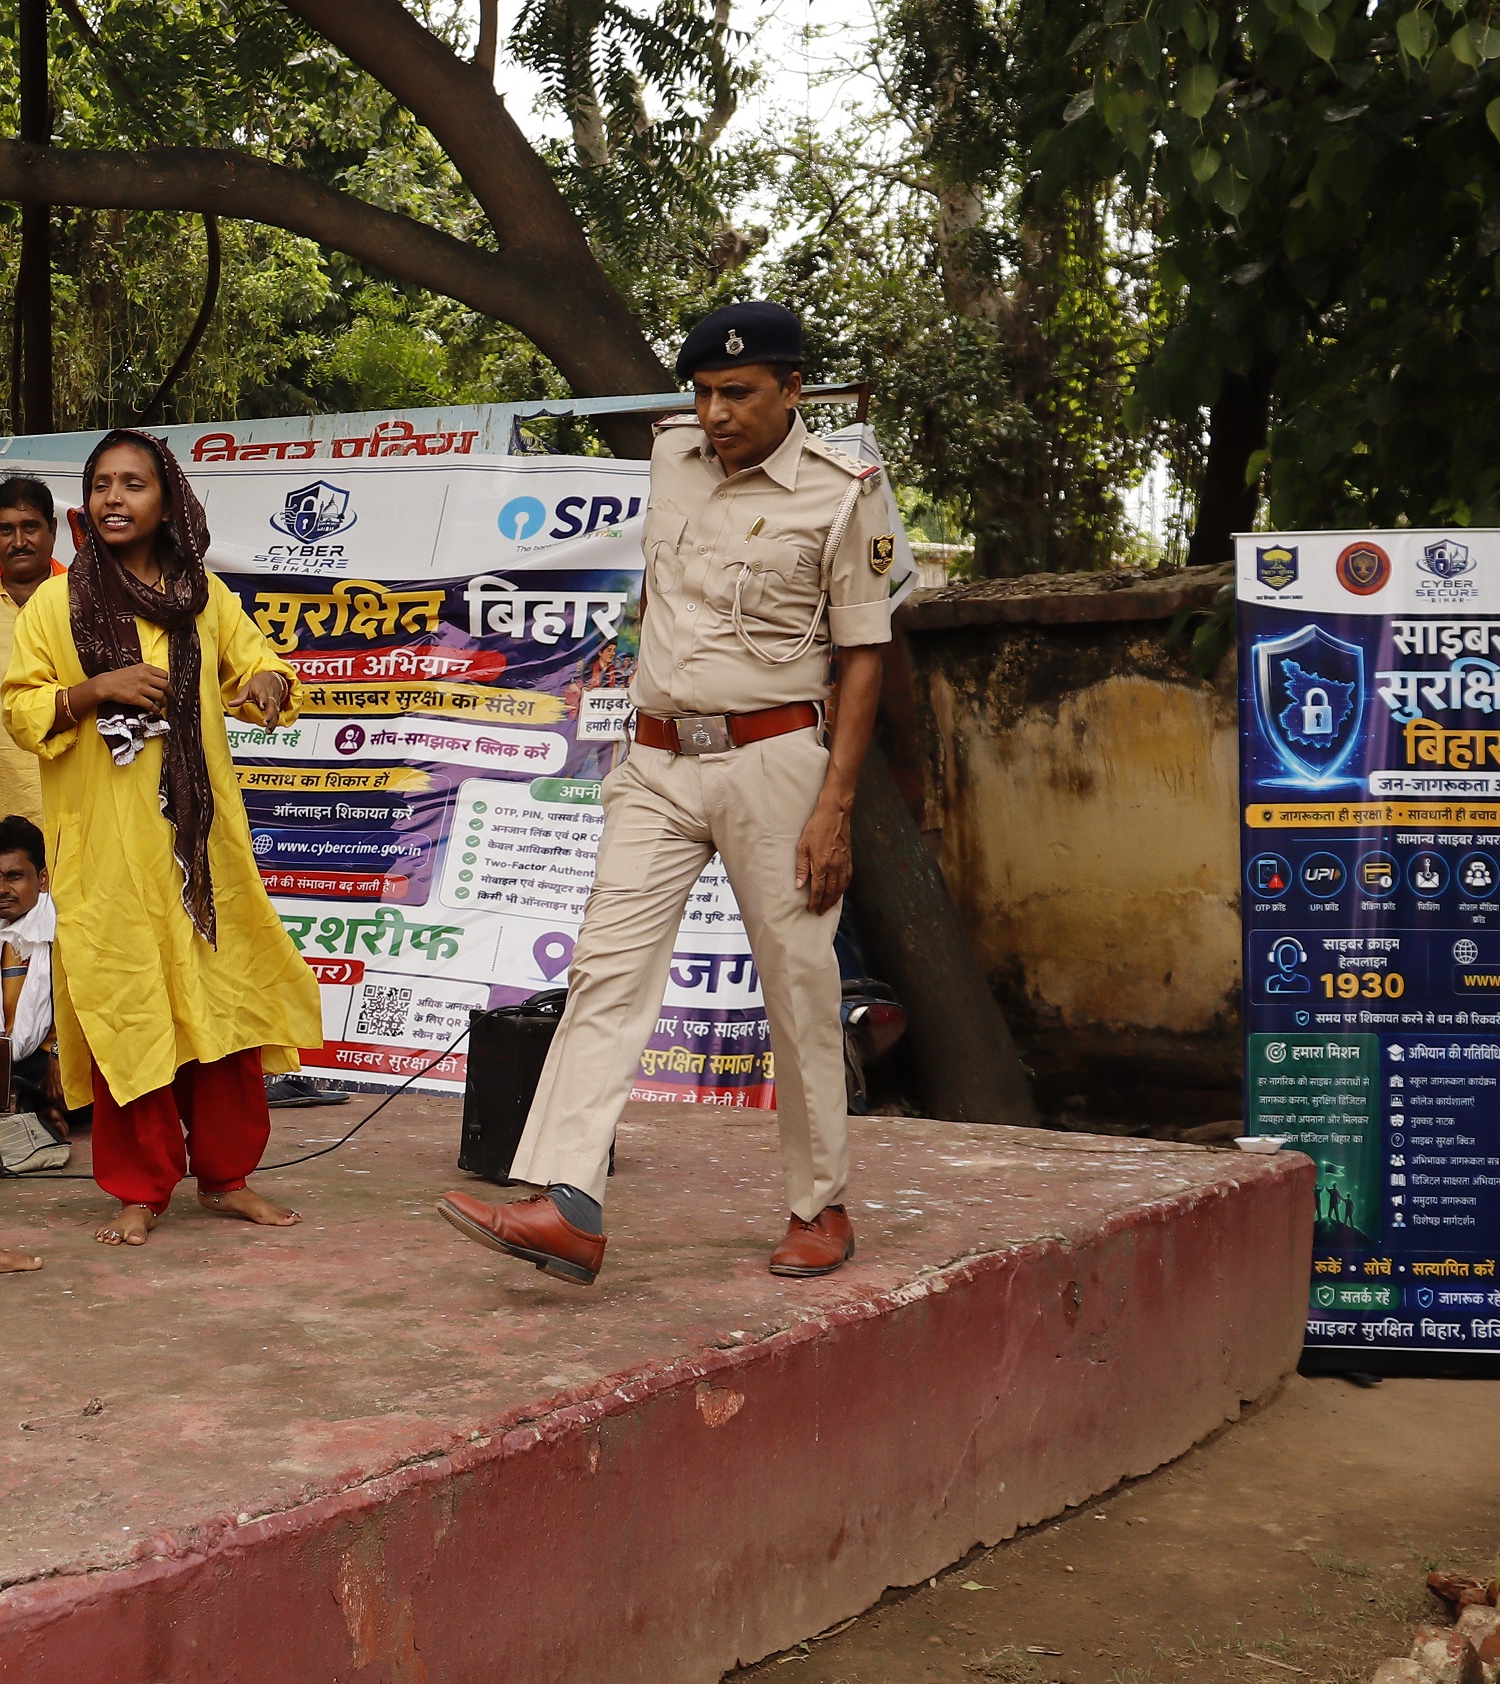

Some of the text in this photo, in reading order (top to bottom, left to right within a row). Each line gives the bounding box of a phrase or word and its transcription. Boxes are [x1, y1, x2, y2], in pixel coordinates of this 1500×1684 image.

[268, 545, 344, 557] CYBER
[252, 554, 350, 569] SECURE
[272, 564, 322, 574] BIHAR
[1421, 580, 1473, 588] CYBER
[1415, 589, 1479, 597] SECURE
[253, 575, 628, 654] सुरक्षित बिहार
[363, 648, 474, 677] अभियान
[309, 688, 326, 706] से
[332, 690, 391, 709] साइबर
[394, 689, 448, 710] सुरक्षा
[451, 692, 479, 710] का
[485, 694, 535, 716] संदेश
[282, 729, 302, 748] रहें
[370, 730, 551, 760] सोच-समझकर क्लिक करें
[300, 774, 321, 788] का
[324, 772, 372, 788] शिकार
[1378, 778, 1490, 792] जन-जागरूकता
[272, 802, 415, 821] ऑनलाइन शिकायत करें
[494, 806, 519, 818] OTP,
[522, 809, 544, 821] PIN,
[1279, 810, 1335, 821] जागरूकता
[1338, 808, 1350, 822] ही
[1353, 809, 1382, 824] सुरक्षा
[1408, 807, 1452, 820] सावधानी
[1456, 807, 1466, 821] ही
[1469, 810, 1497, 821] बचाव
[491, 824, 528, 836] अनजान
[529, 826, 552, 838] लिंक
[571, 832, 588, 841] QR
[1396, 833, 1474, 847] सामान्य साइबर
[276, 841, 422, 857] www.cybercrime.gov.in
[487, 838, 514, 852] केवल
[484, 857, 547, 872] Two-Factor
[480, 874, 518, 886] मोबाइल
[1305, 868, 1335, 881] UPI
[280, 876, 294, 888] की
[356, 880, 380, 891] जाती
[477, 890, 502, 902] किसी
[505, 893, 518, 904] भी
[1255, 903, 1271, 912] OTP
[1310, 903, 1323, 912] UPI
[689, 910, 703, 922] की
[1322, 938, 1400, 953] साइबर क्राइम
[1338, 954, 1388, 969] हेल्पलाइन
[1320, 972, 1405, 999] 1930
[426, 1013, 445, 1026] लिए
[446, 1017, 461, 1027] QR
[1315, 1012, 1341, 1024] समय
[1344, 1012, 1357, 1024] पर
[1359, 1010, 1399, 1024] शिकायत
[1401, 1011, 1424, 1024] करने
[1426, 1010, 1435, 1024] से
[1456, 1011, 1469, 1025] की
[682, 1020, 756, 1041] एक साइबर
[1292, 1043, 1360, 1060] हमारा मिशन
[1408, 1043, 1446, 1059] अभियान
[1448, 1043, 1461, 1059] की
[336, 1049, 384, 1067] साइबर
[435, 1056, 458, 1074] की
[640, 1046, 755, 1077] सुरक्षित समाज
[1269, 1075, 1295, 1086] नागरिक
[1297, 1075, 1307, 1086] को
[1309, 1077, 1332, 1087] साइबर
[1363, 1076, 1370, 1086] से
[1430, 1077, 1466, 1086] जागरूकता
[1259, 1095, 1287, 1105] जागरूक
[1338, 1094, 1367, 1105] डिजिटल
[1286, 1113, 1296, 1124] को
[1328, 1113, 1340, 1124] और
[1342, 1113, 1369, 1124] मिलकर
[1435, 1118, 1456, 1126] नाटक
[1300, 1132, 1329, 1143] डिजिटल
[1331, 1132, 1351, 1144] बिहार
[1411, 1136, 1434, 1146] साइबर
[1449, 1156, 1485, 1166] जागरूकता
[1412, 1173, 1440, 1185] डिजिटल
[1440, 1196, 1477, 1206] जागरूकता
[1363, 1257, 1393, 1276] सोचें
[1412, 1258, 1470, 1276] सत्यापित
[1473, 1259, 1496, 1277] करें
[1340, 1287, 1485, 1306] सतर्क रहें जागरूक
[1307, 1317, 1466, 1342] साइबर सुरक्षित बिहार,
